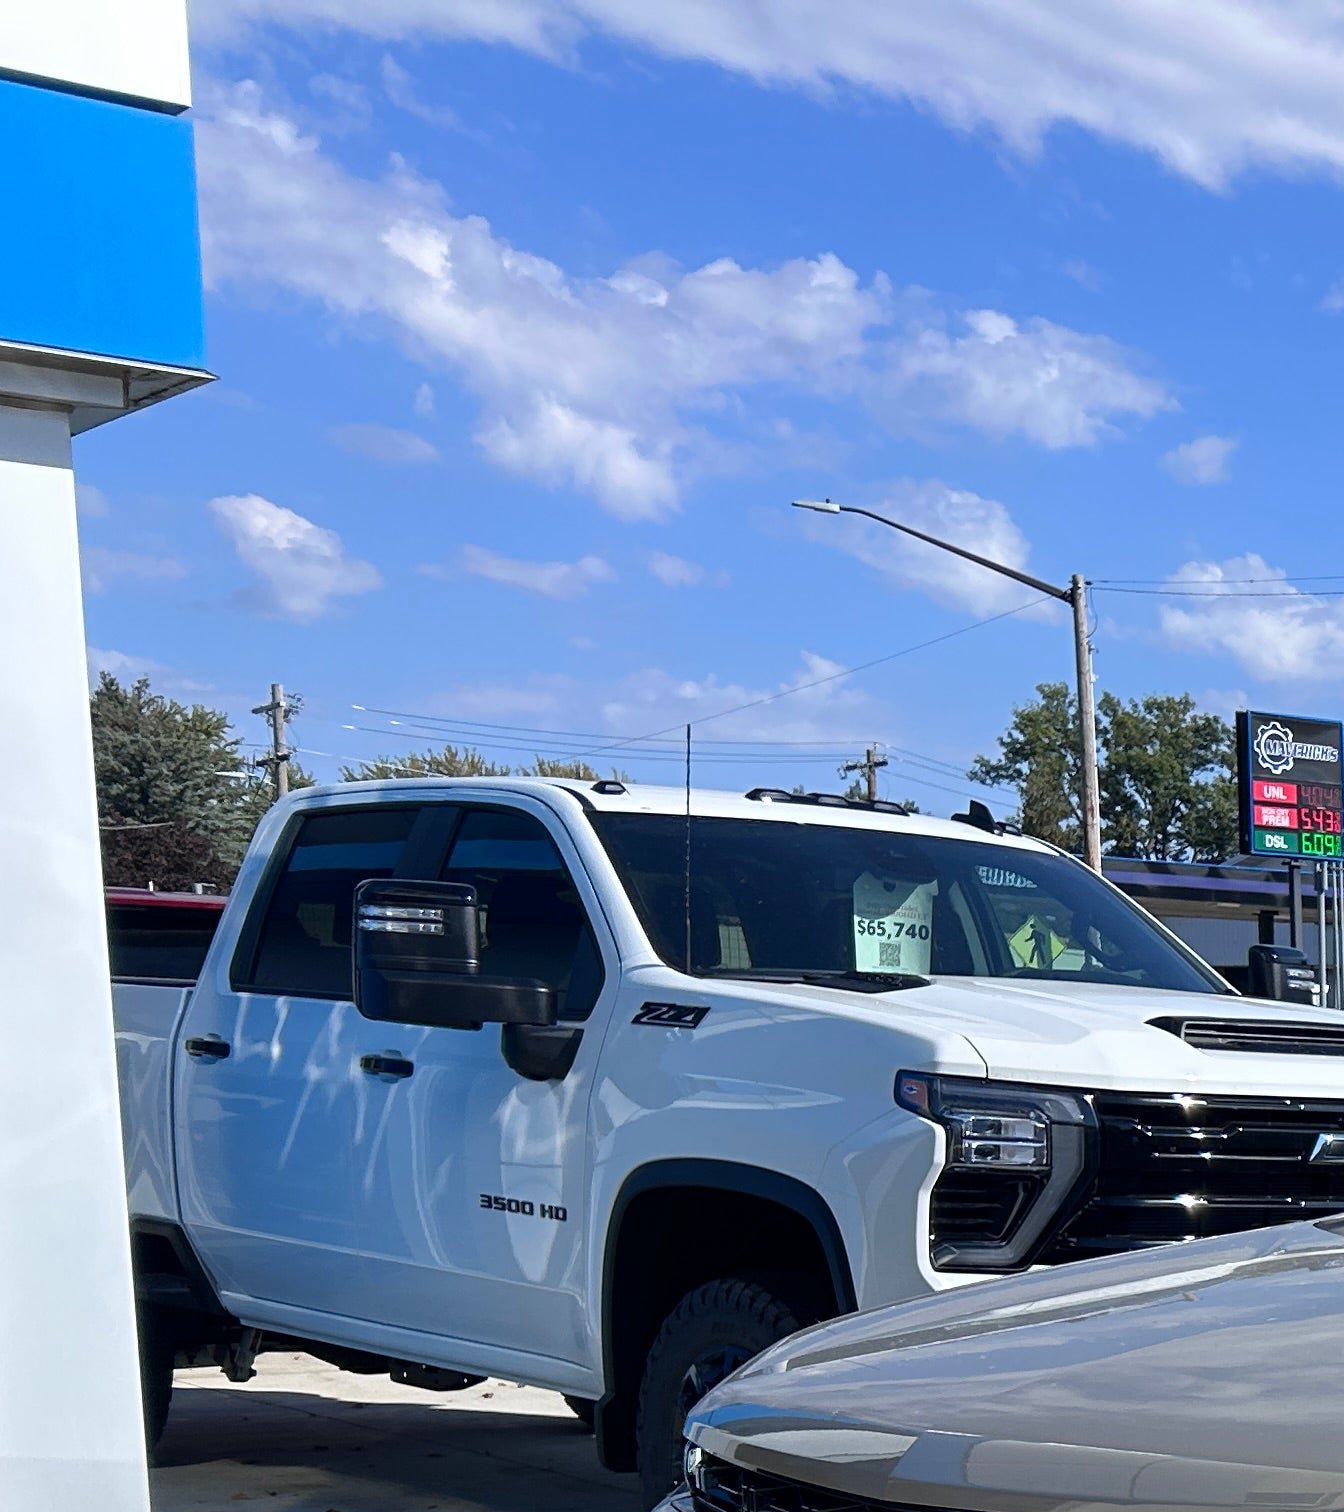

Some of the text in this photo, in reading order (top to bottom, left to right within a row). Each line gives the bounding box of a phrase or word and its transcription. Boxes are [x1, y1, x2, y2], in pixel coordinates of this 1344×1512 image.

[1263, 784, 1287, 800] UNL
[1262, 814, 1290, 828] PREM
[1265, 833, 1288, 849] DSL
[857, 919, 930, 941] $65,740
[479, 1194, 568, 1222] 3500 HD
